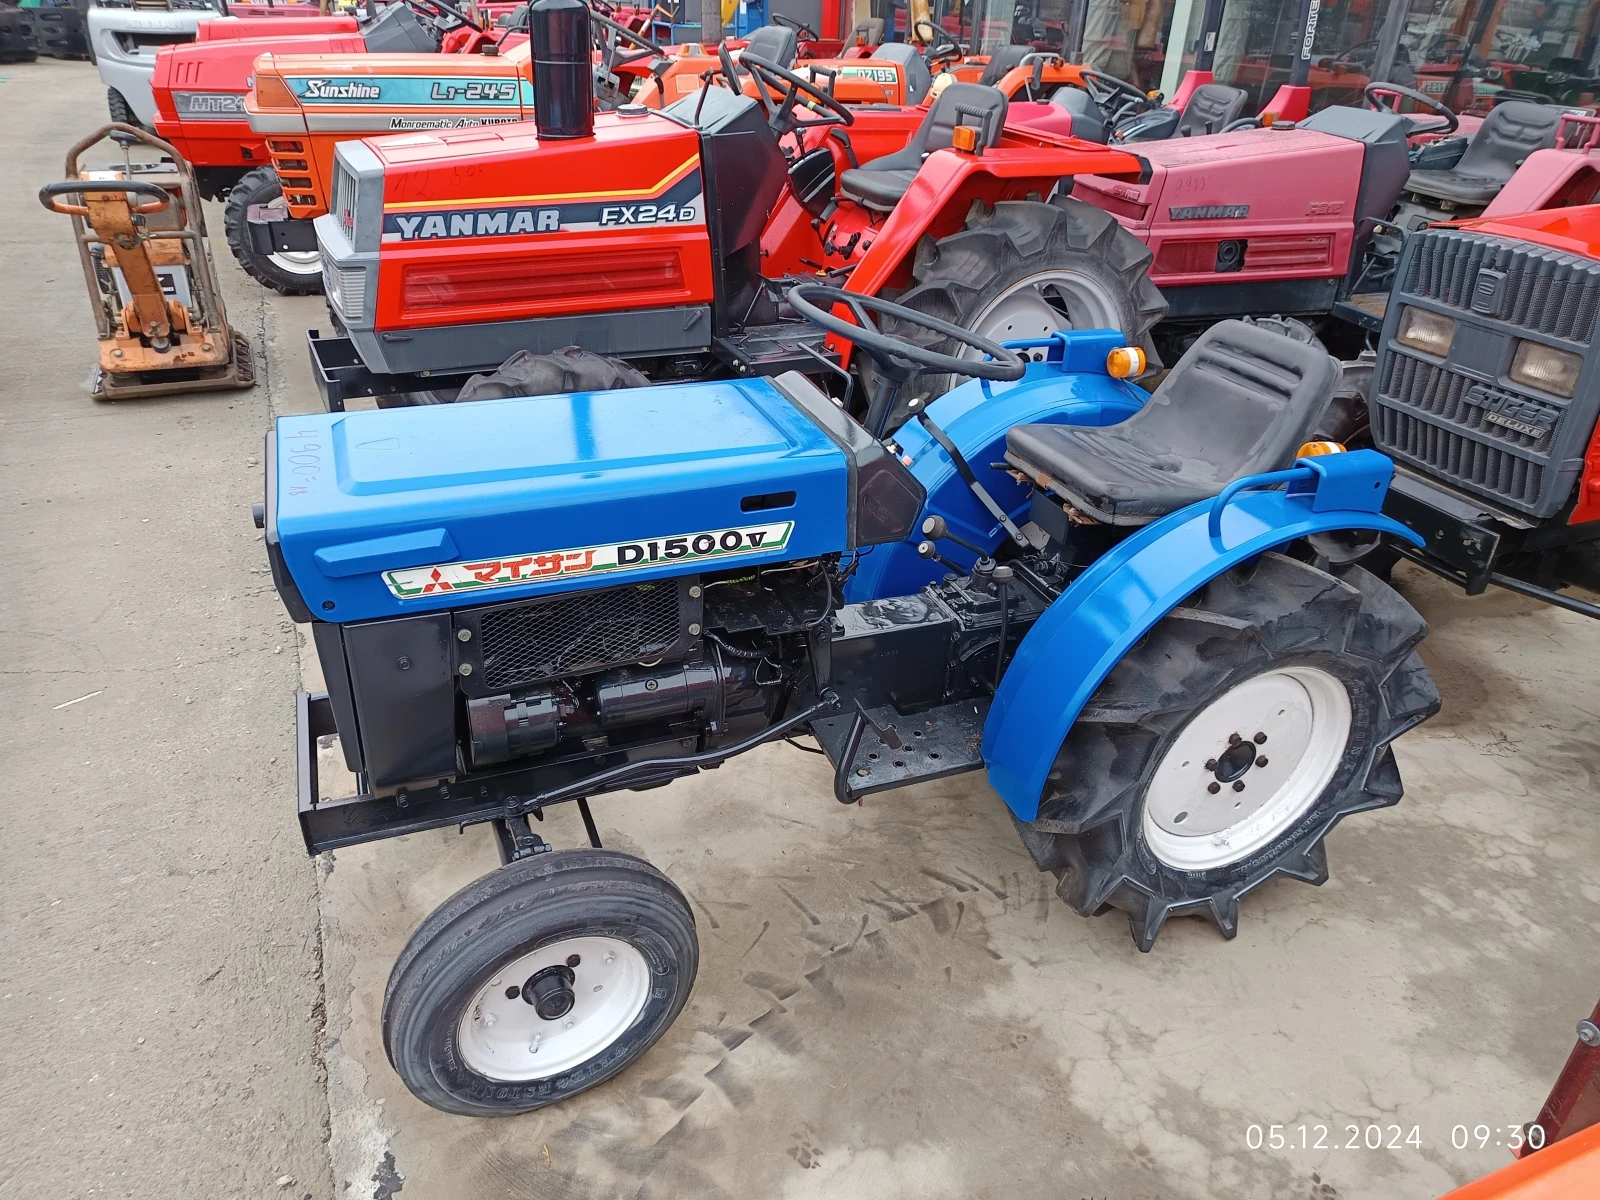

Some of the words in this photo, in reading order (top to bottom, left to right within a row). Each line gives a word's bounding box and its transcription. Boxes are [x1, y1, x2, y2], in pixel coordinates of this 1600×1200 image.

[125, 20, 184, 31] NISSAN
[1301, 0, 1320, 60] FORTE
[299, 79, 381, 99] Sunshine
[431, 82, 517, 100] L1-245
[390, 118, 451, 129] Monroematic
[455, 118, 479, 129] Auto
[396, 209, 561, 239] YANMAR
[600, 203, 697, 226] FX24D
[1169, 205, 1250, 220] YANMAR
[1486, 413, 1544, 438] DELUXE
[462, 549, 597, 582] マイサン
